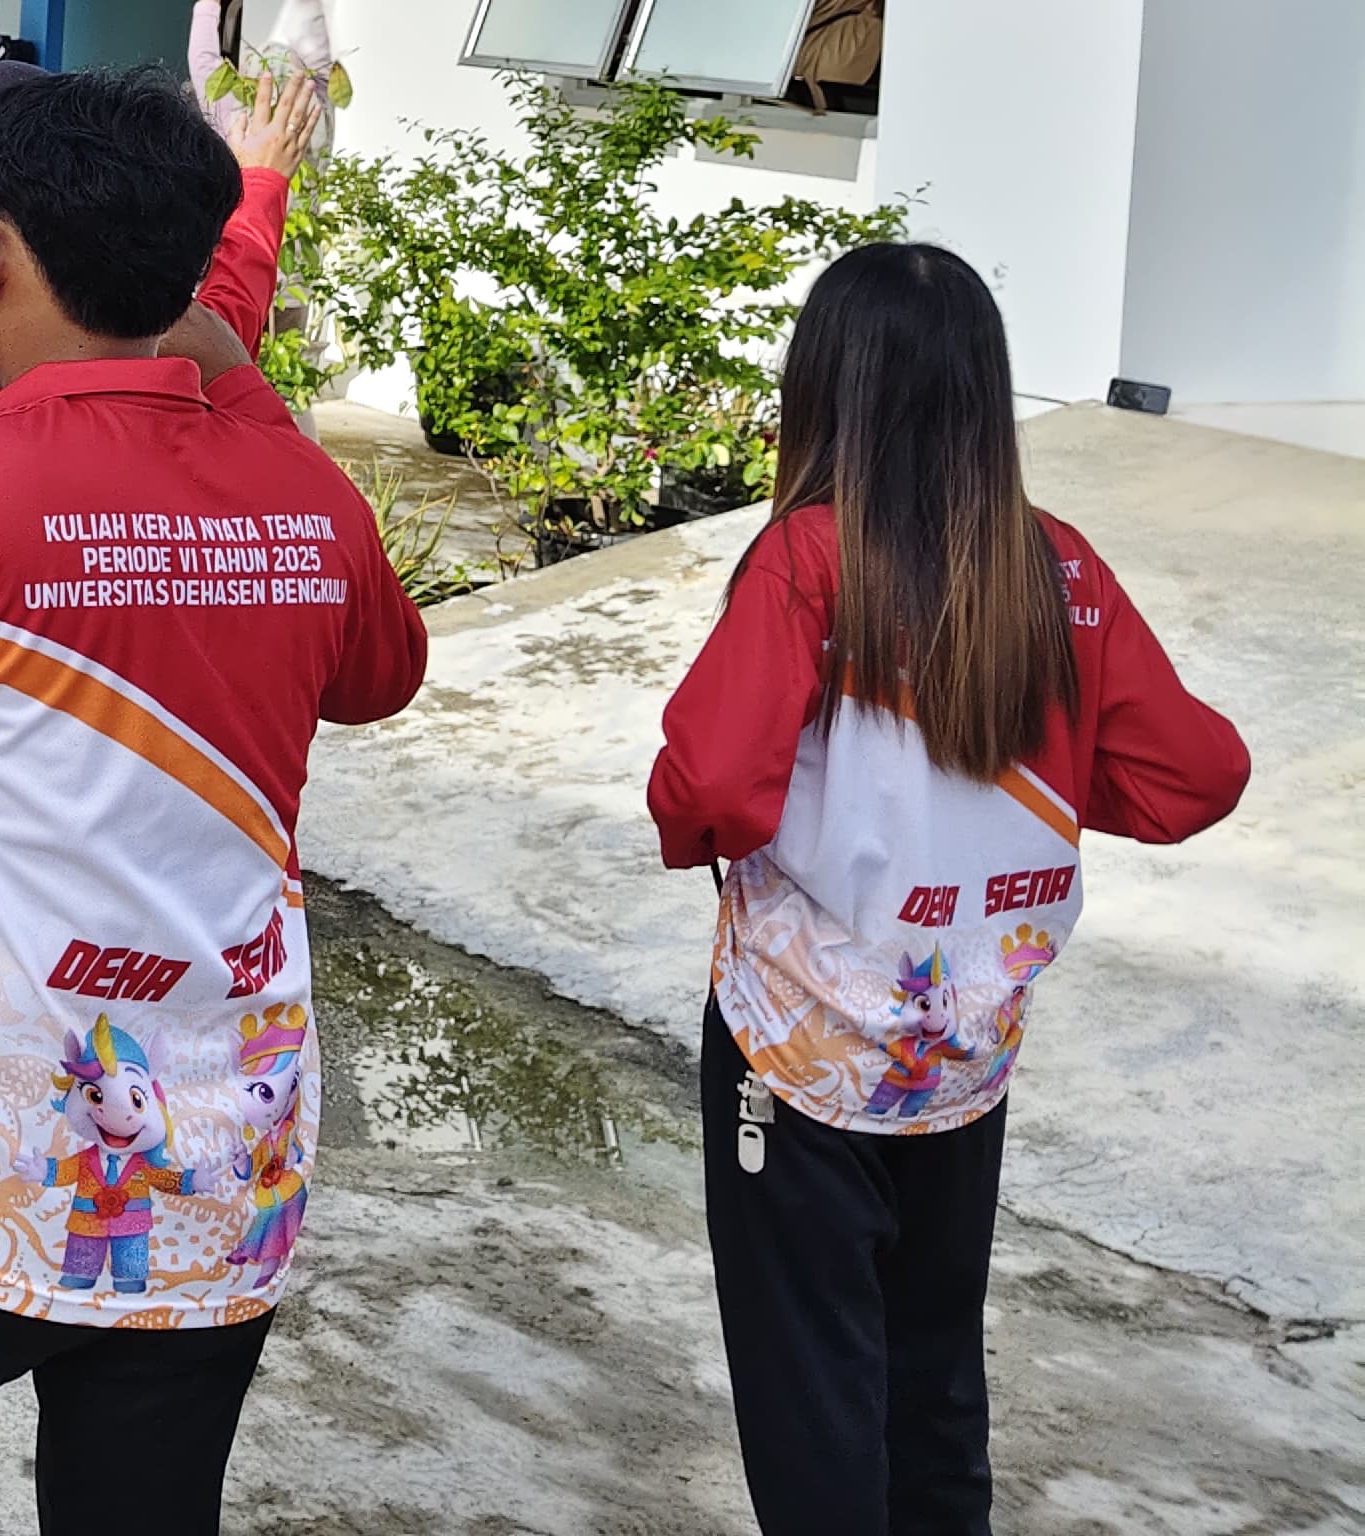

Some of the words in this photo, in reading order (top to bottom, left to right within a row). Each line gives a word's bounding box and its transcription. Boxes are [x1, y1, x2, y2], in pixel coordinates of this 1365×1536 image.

[43, 513, 127, 542] KULIAH
[131, 513, 198, 541] KERJA
[198, 516, 262, 542] NYATA
[261, 514, 336, 541] TEMATIK
[82, 545, 172, 574] PERIODE
[178, 547, 199, 573] VI
[201, 547, 268, 573] TAHUN
[272, 545, 321, 572] 2025
[24, 578, 170, 609] UNIVERSITAS
[171, 579, 266, 606] DEHASEN
[270, 577, 348, 604] BENGKULU
[985, 865, 1076, 918] SENA
[46, 939, 192, 1002] DEHA
[221, 907, 287, 999] SENA
